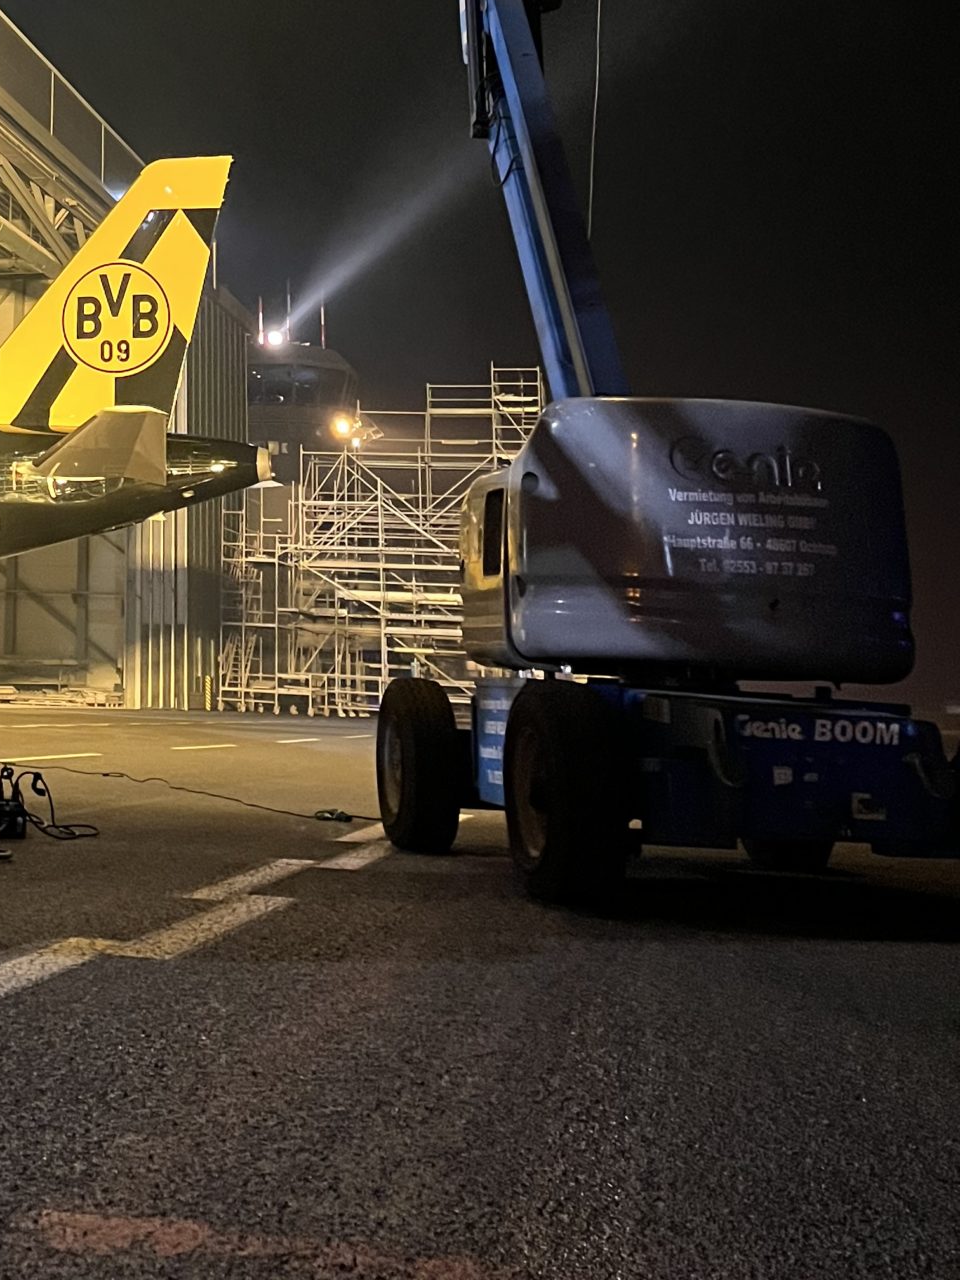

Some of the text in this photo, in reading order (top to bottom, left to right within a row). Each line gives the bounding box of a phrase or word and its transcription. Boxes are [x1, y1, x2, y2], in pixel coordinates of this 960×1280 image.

[76, 272, 159, 340] BVB
[100, 339, 130, 363] 09
[668, 487, 734, 505] Vermietung
[687, 509, 735, 526] JÜRGEN
[737, 513, 785, 528] WIELING
[668, 535, 737, 553] Hauptstraße
[739, 536, 754, 551] 66
[698, 558, 720, 572] Tel.
[814, 720, 900, 746] BOOM
